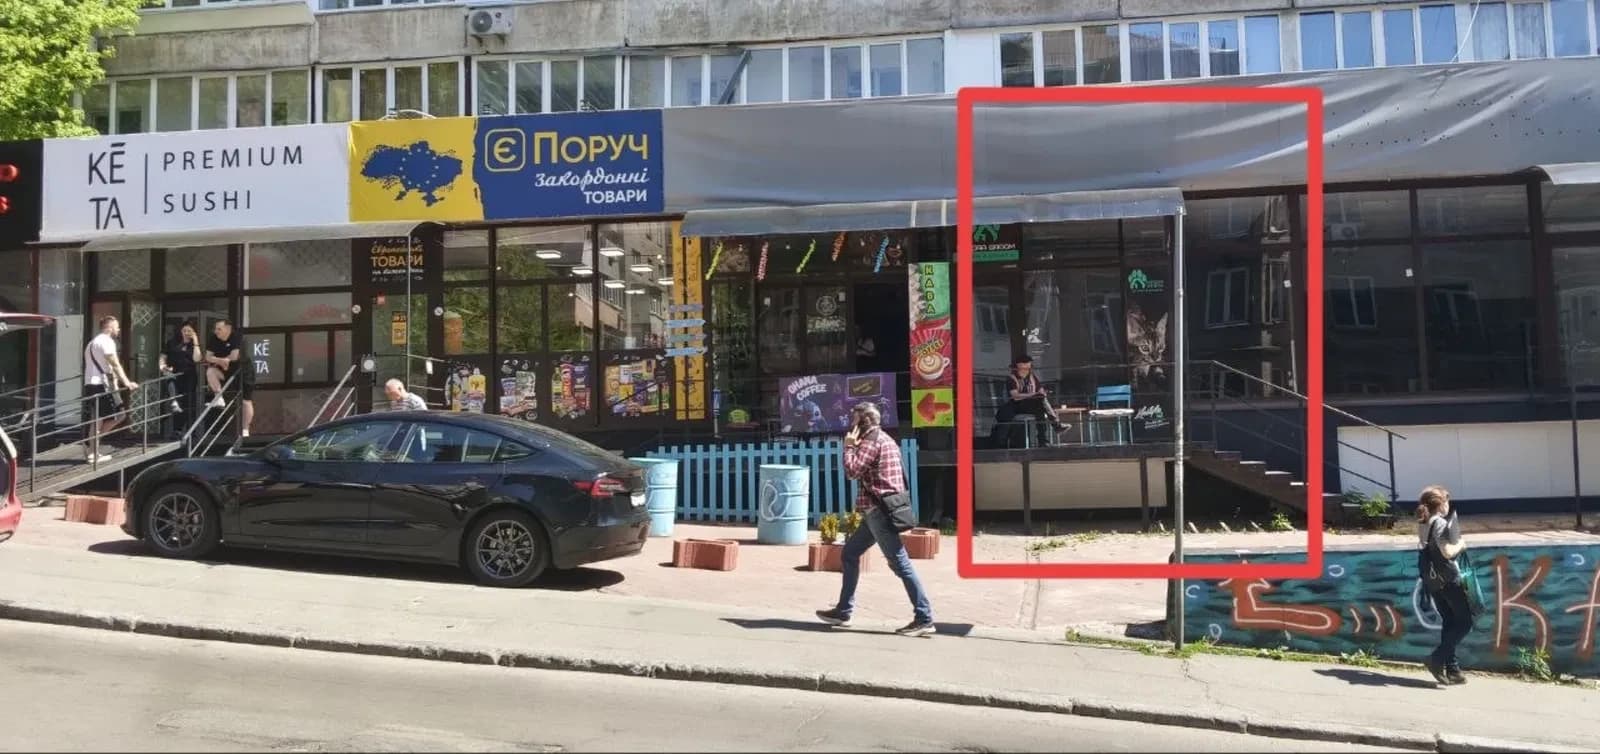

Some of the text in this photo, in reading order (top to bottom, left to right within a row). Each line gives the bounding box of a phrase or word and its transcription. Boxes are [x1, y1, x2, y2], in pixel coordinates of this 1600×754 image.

[163, 145, 302, 171] PREMIUM
[493, 136, 517, 163] Є
[88, 142, 126, 186] KĒ
[163, 190, 251, 213] SUSHI
[583, 189, 648, 205] ТОВАРИ
[88, 197, 125, 230] TA
[370, 255, 424, 268] ТОВАРИ
[254, 360, 270, 374] TA
[787, 375, 819, 395] OHANA
[796, 383, 828, 401] COFFEE
